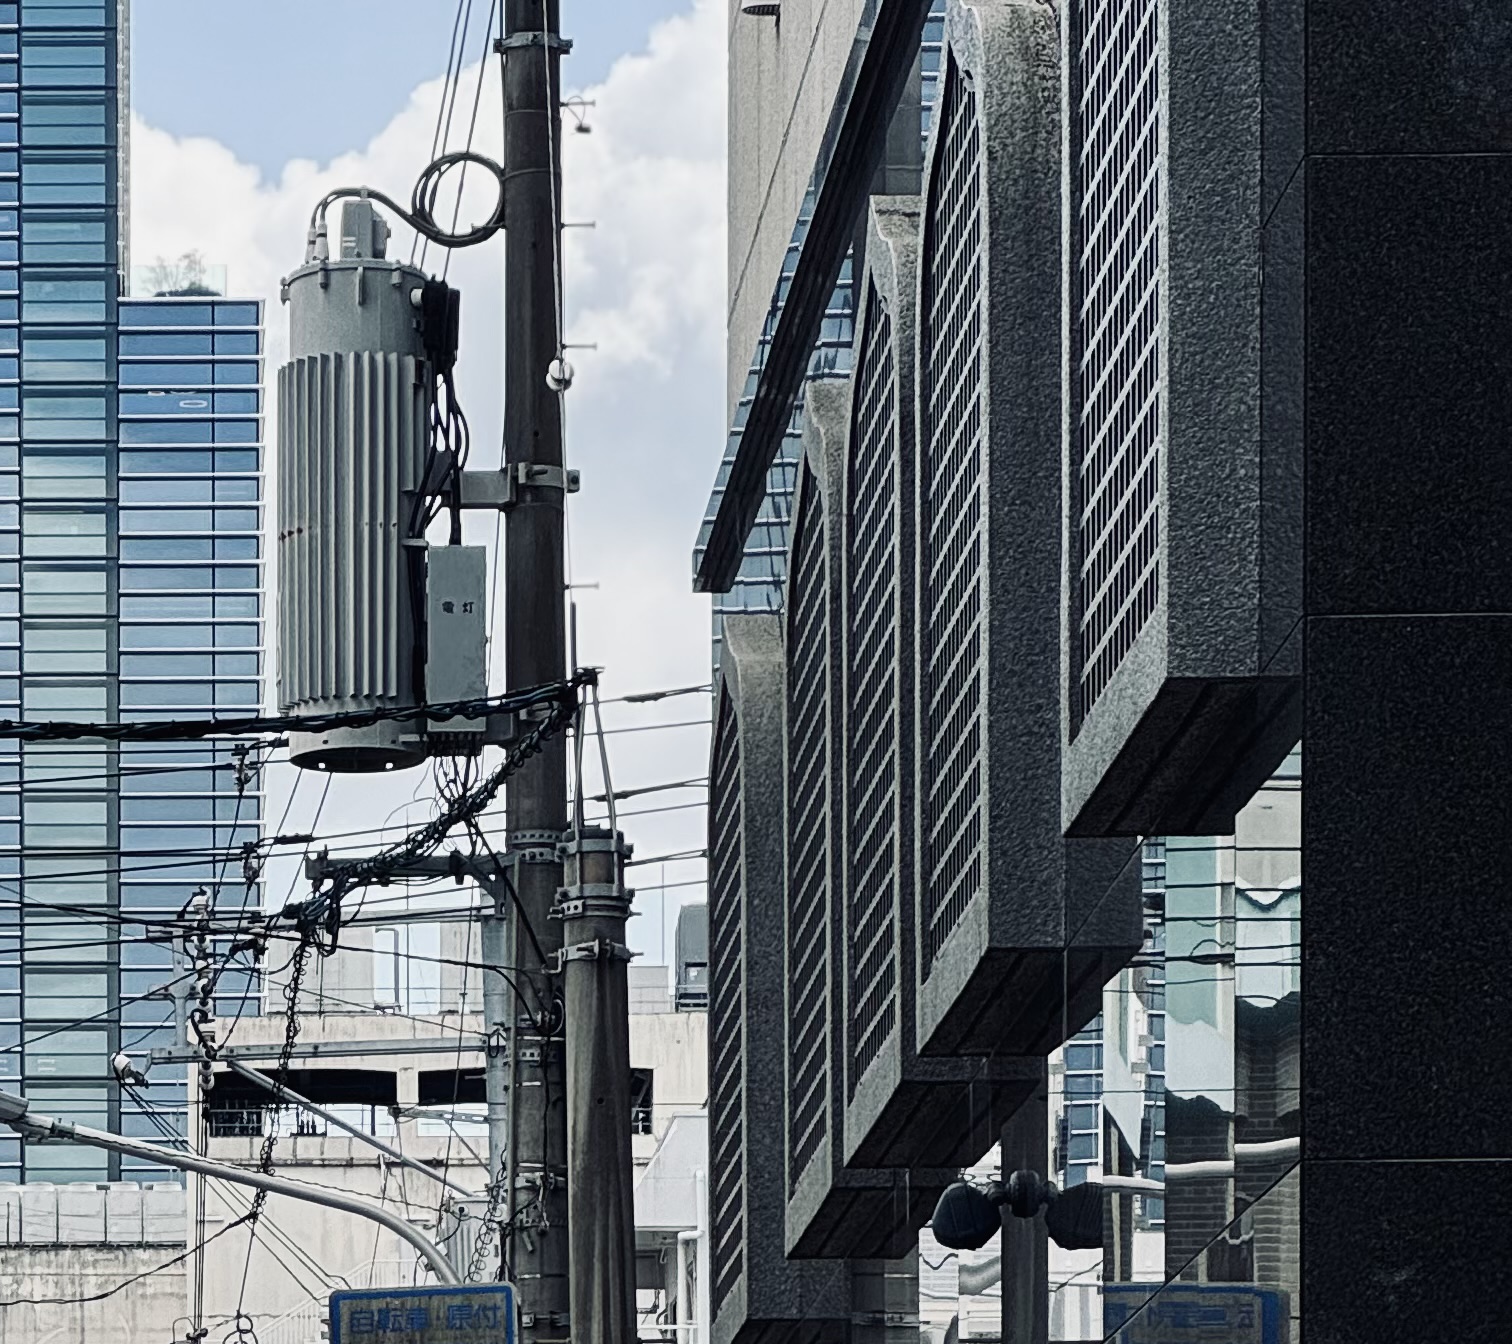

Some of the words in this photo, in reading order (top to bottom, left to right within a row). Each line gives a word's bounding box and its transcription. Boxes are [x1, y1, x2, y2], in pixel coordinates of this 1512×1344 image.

[350, 1308, 429, 1334] 自転車
[447, 1304, 502, 1331] 原付
